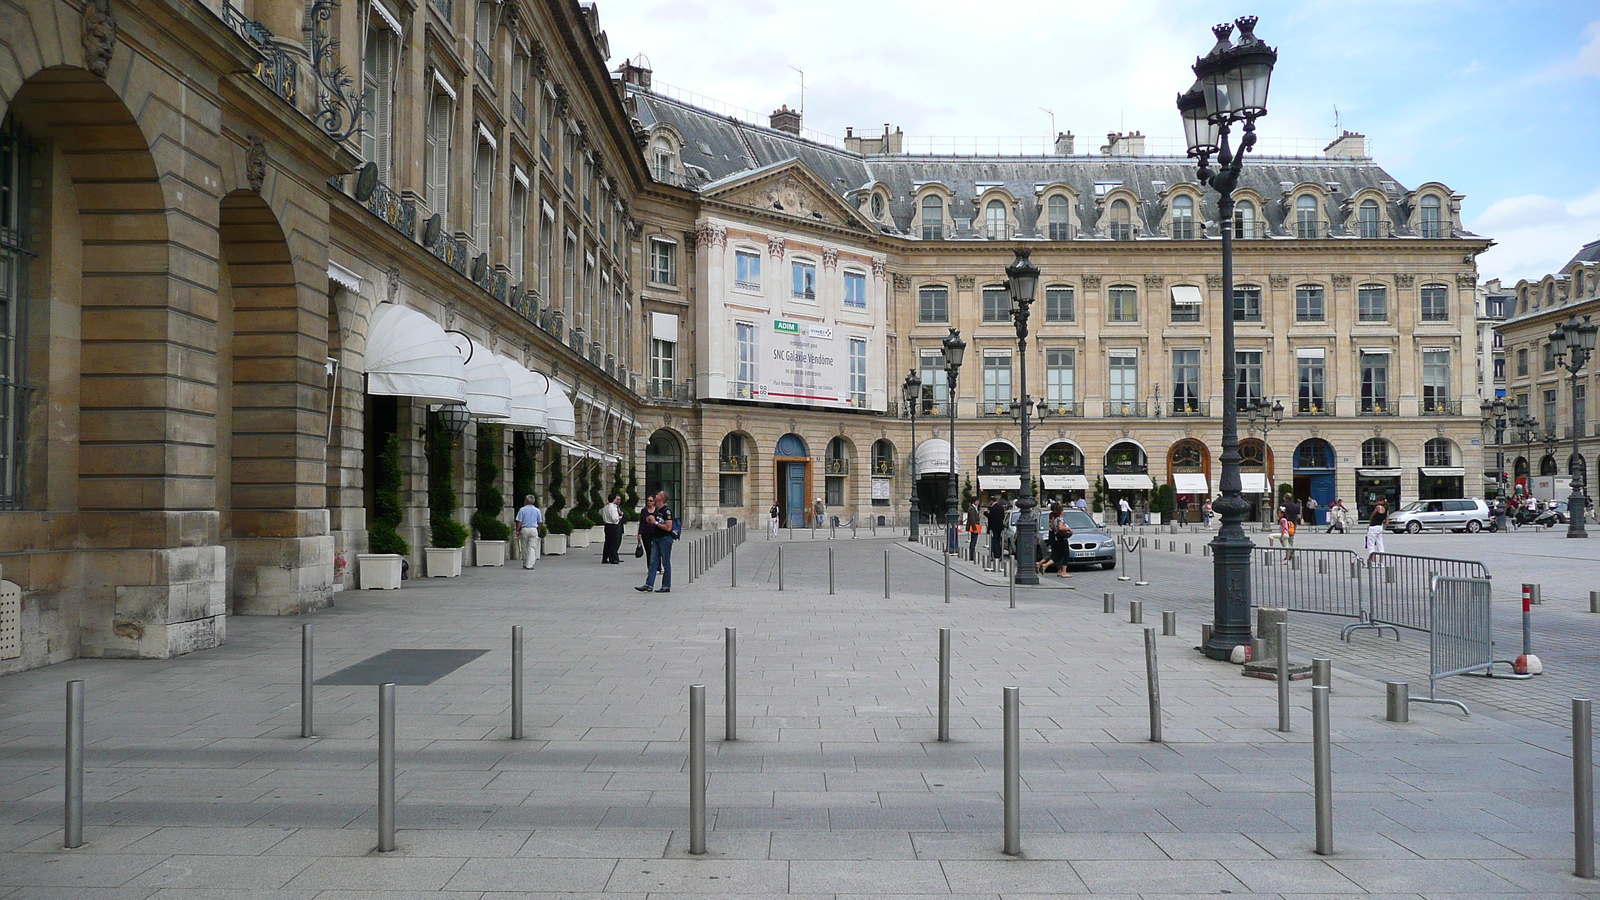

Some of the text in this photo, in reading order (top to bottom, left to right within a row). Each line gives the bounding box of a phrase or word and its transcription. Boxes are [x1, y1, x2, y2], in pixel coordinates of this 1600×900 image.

[778, 322, 794, 330] ADIM
[773, 349, 833, 366] SNC Galaxie Vendôme
